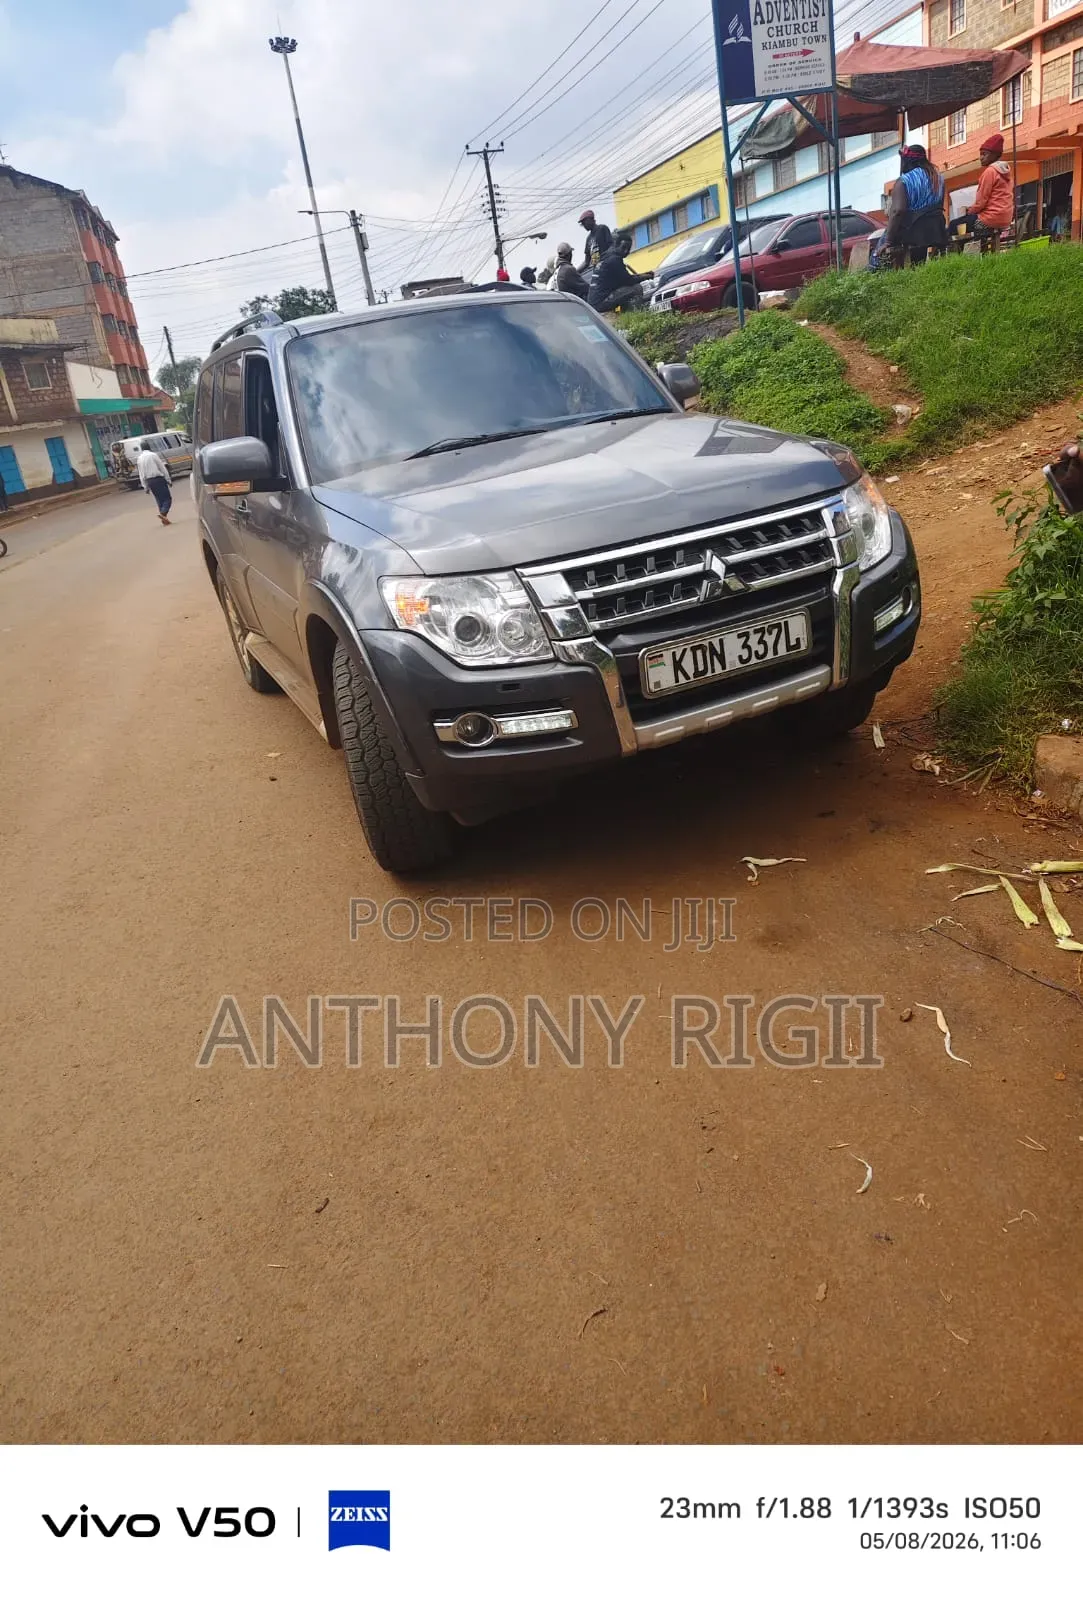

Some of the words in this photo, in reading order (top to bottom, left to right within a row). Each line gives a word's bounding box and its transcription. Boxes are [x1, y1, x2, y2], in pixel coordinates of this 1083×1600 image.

[753, 0, 826, 25] ADVENTIST
[767, 21, 818, 38] CHURCH
[762, 37, 798, 51] KIAMBU
[802, 34, 827, 46] TOWN
[672, 638, 727, 684] KDN
[737, 620, 801, 664] 337L
